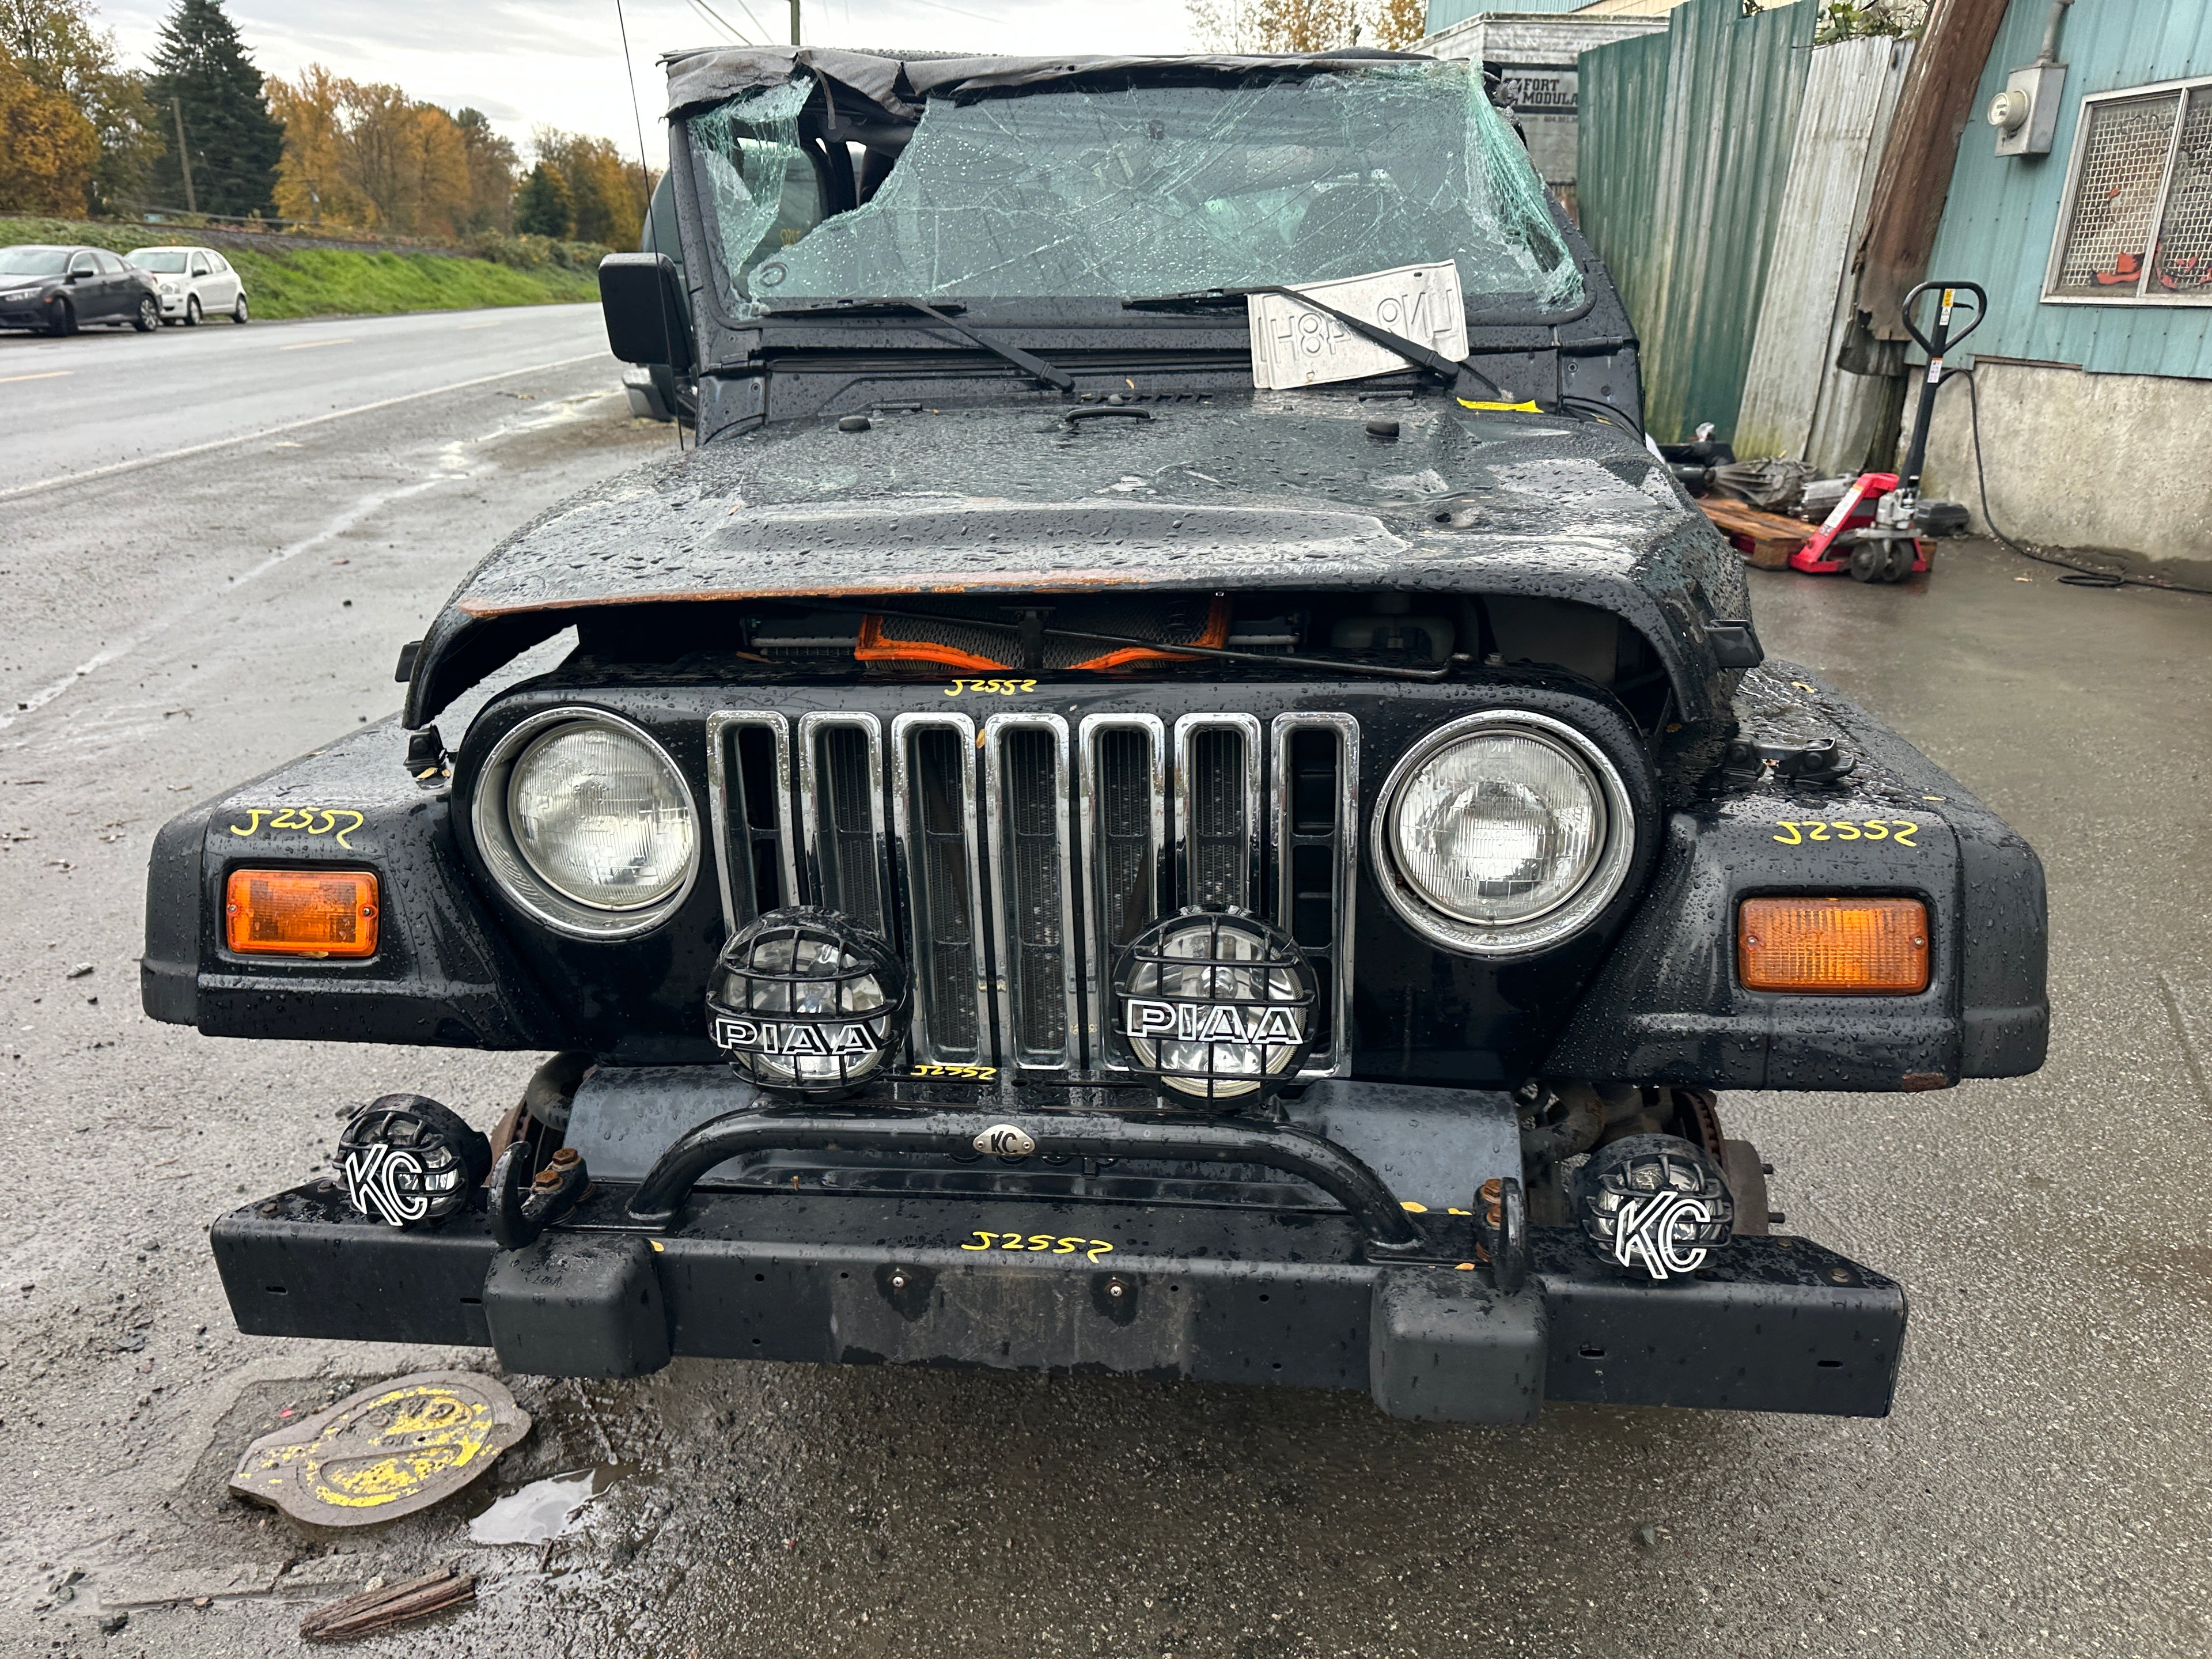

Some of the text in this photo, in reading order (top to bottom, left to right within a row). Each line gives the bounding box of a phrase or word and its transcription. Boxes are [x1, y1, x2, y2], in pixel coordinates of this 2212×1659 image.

[1524, 78, 1560, 91] FORT
[944, 679, 1037, 696] J2552
[1772, 820, 1919, 847] J2552
[716, 1018, 878, 1055] PIAA
[1127, 999, 1304, 1044] PIAA
[991, 1131, 1018, 1154] KC
[346, 1143, 428, 1226] KC
[961, 1231, 1113, 1264] J2552
[1615, 1191, 1711, 1279] KC
